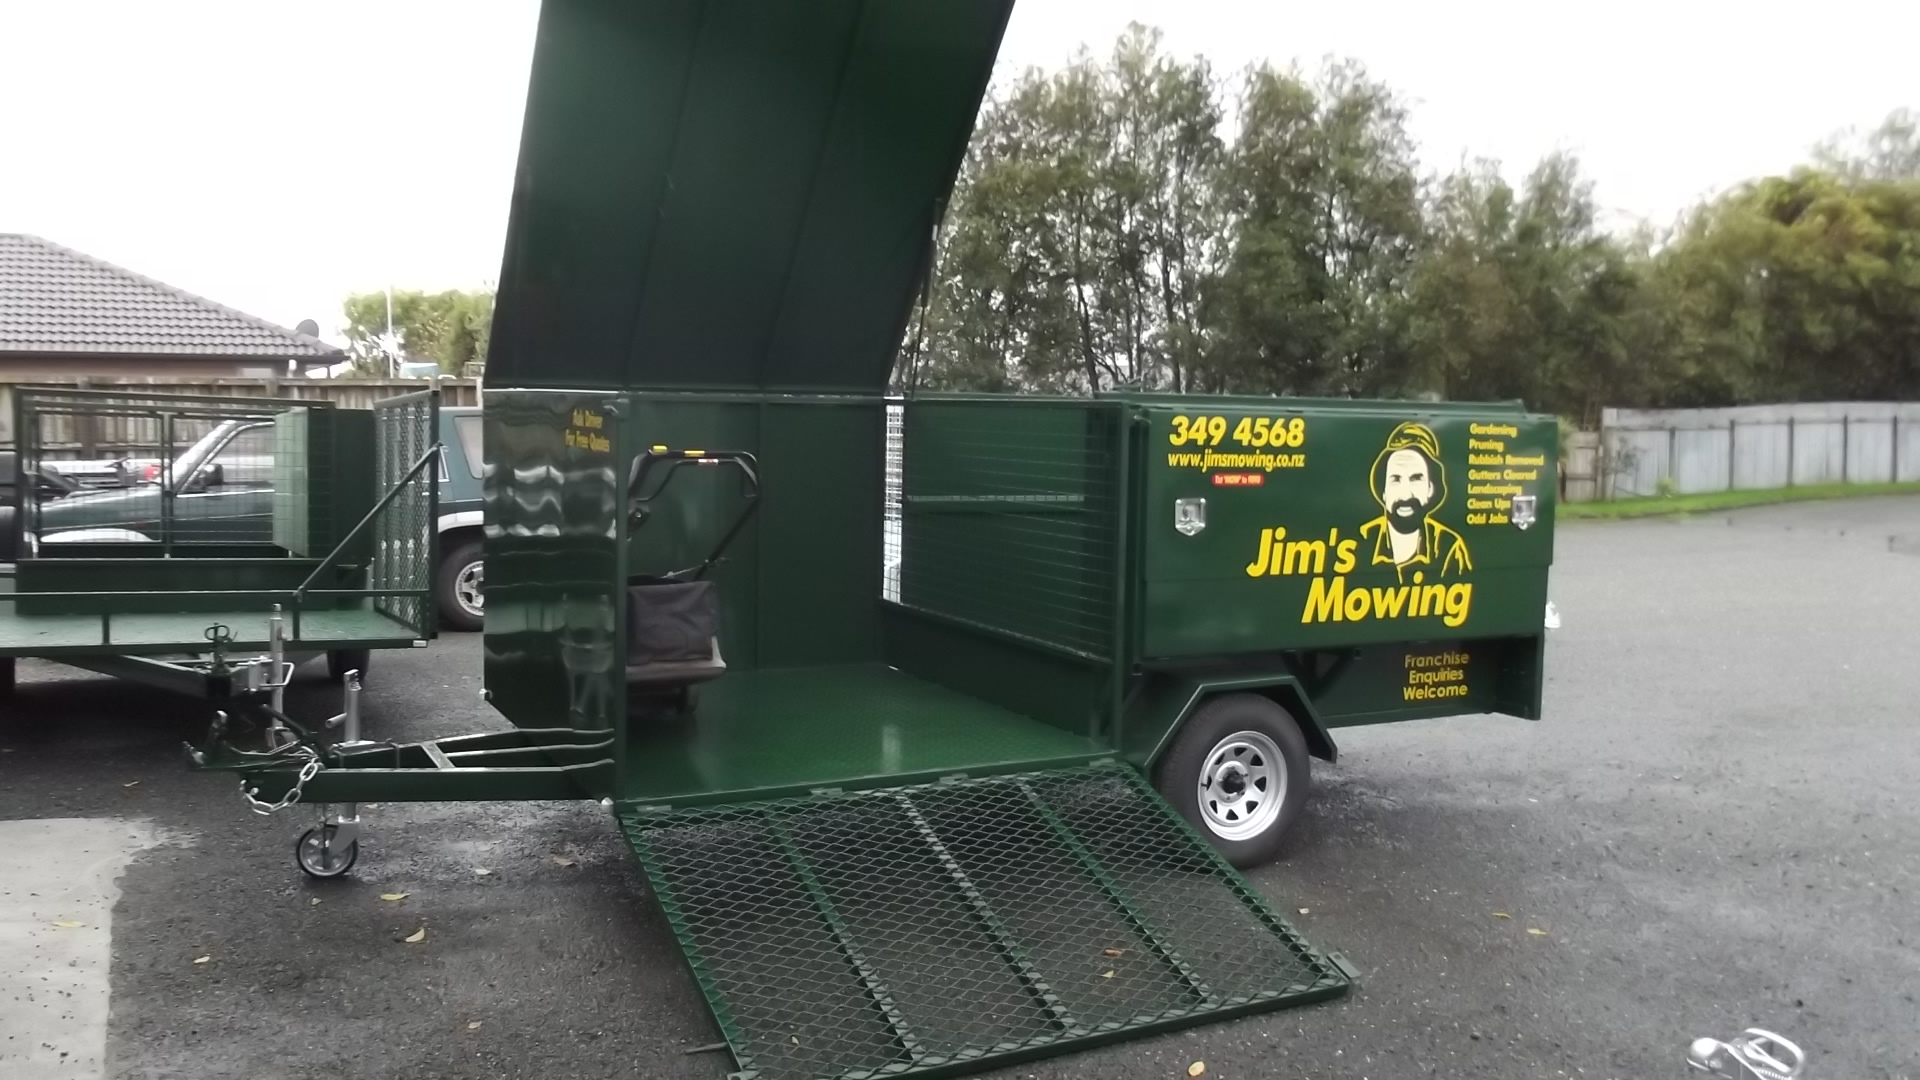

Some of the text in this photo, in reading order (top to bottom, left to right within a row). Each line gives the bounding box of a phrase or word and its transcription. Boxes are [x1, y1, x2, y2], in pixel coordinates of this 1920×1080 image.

[1169, 415, 1305, 448] 349 4568
[1470, 422, 1517, 438] Gardening
[1469, 438, 1504, 453] Pruning
[1168, 449, 1305, 473] www.jimsmowing.co.nz
[1469, 453, 1544, 466] Rubbish Removed
[1468, 468, 1537, 481] Gutters Cleared
[1467, 483, 1522, 497] Landscaping
[1467, 498, 1511, 511] Clean Ups
[1466, 513, 1508, 525] Odd Jobs
[1246, 526, 1357, 577] Jim's
[1301, 571, 1472, 627] Mowing
[1404, 650, 1469, 669] Franchise
[1409, 667, 1464, 685] Enquiries
[1403, 684, 1469, 701] Welcome
